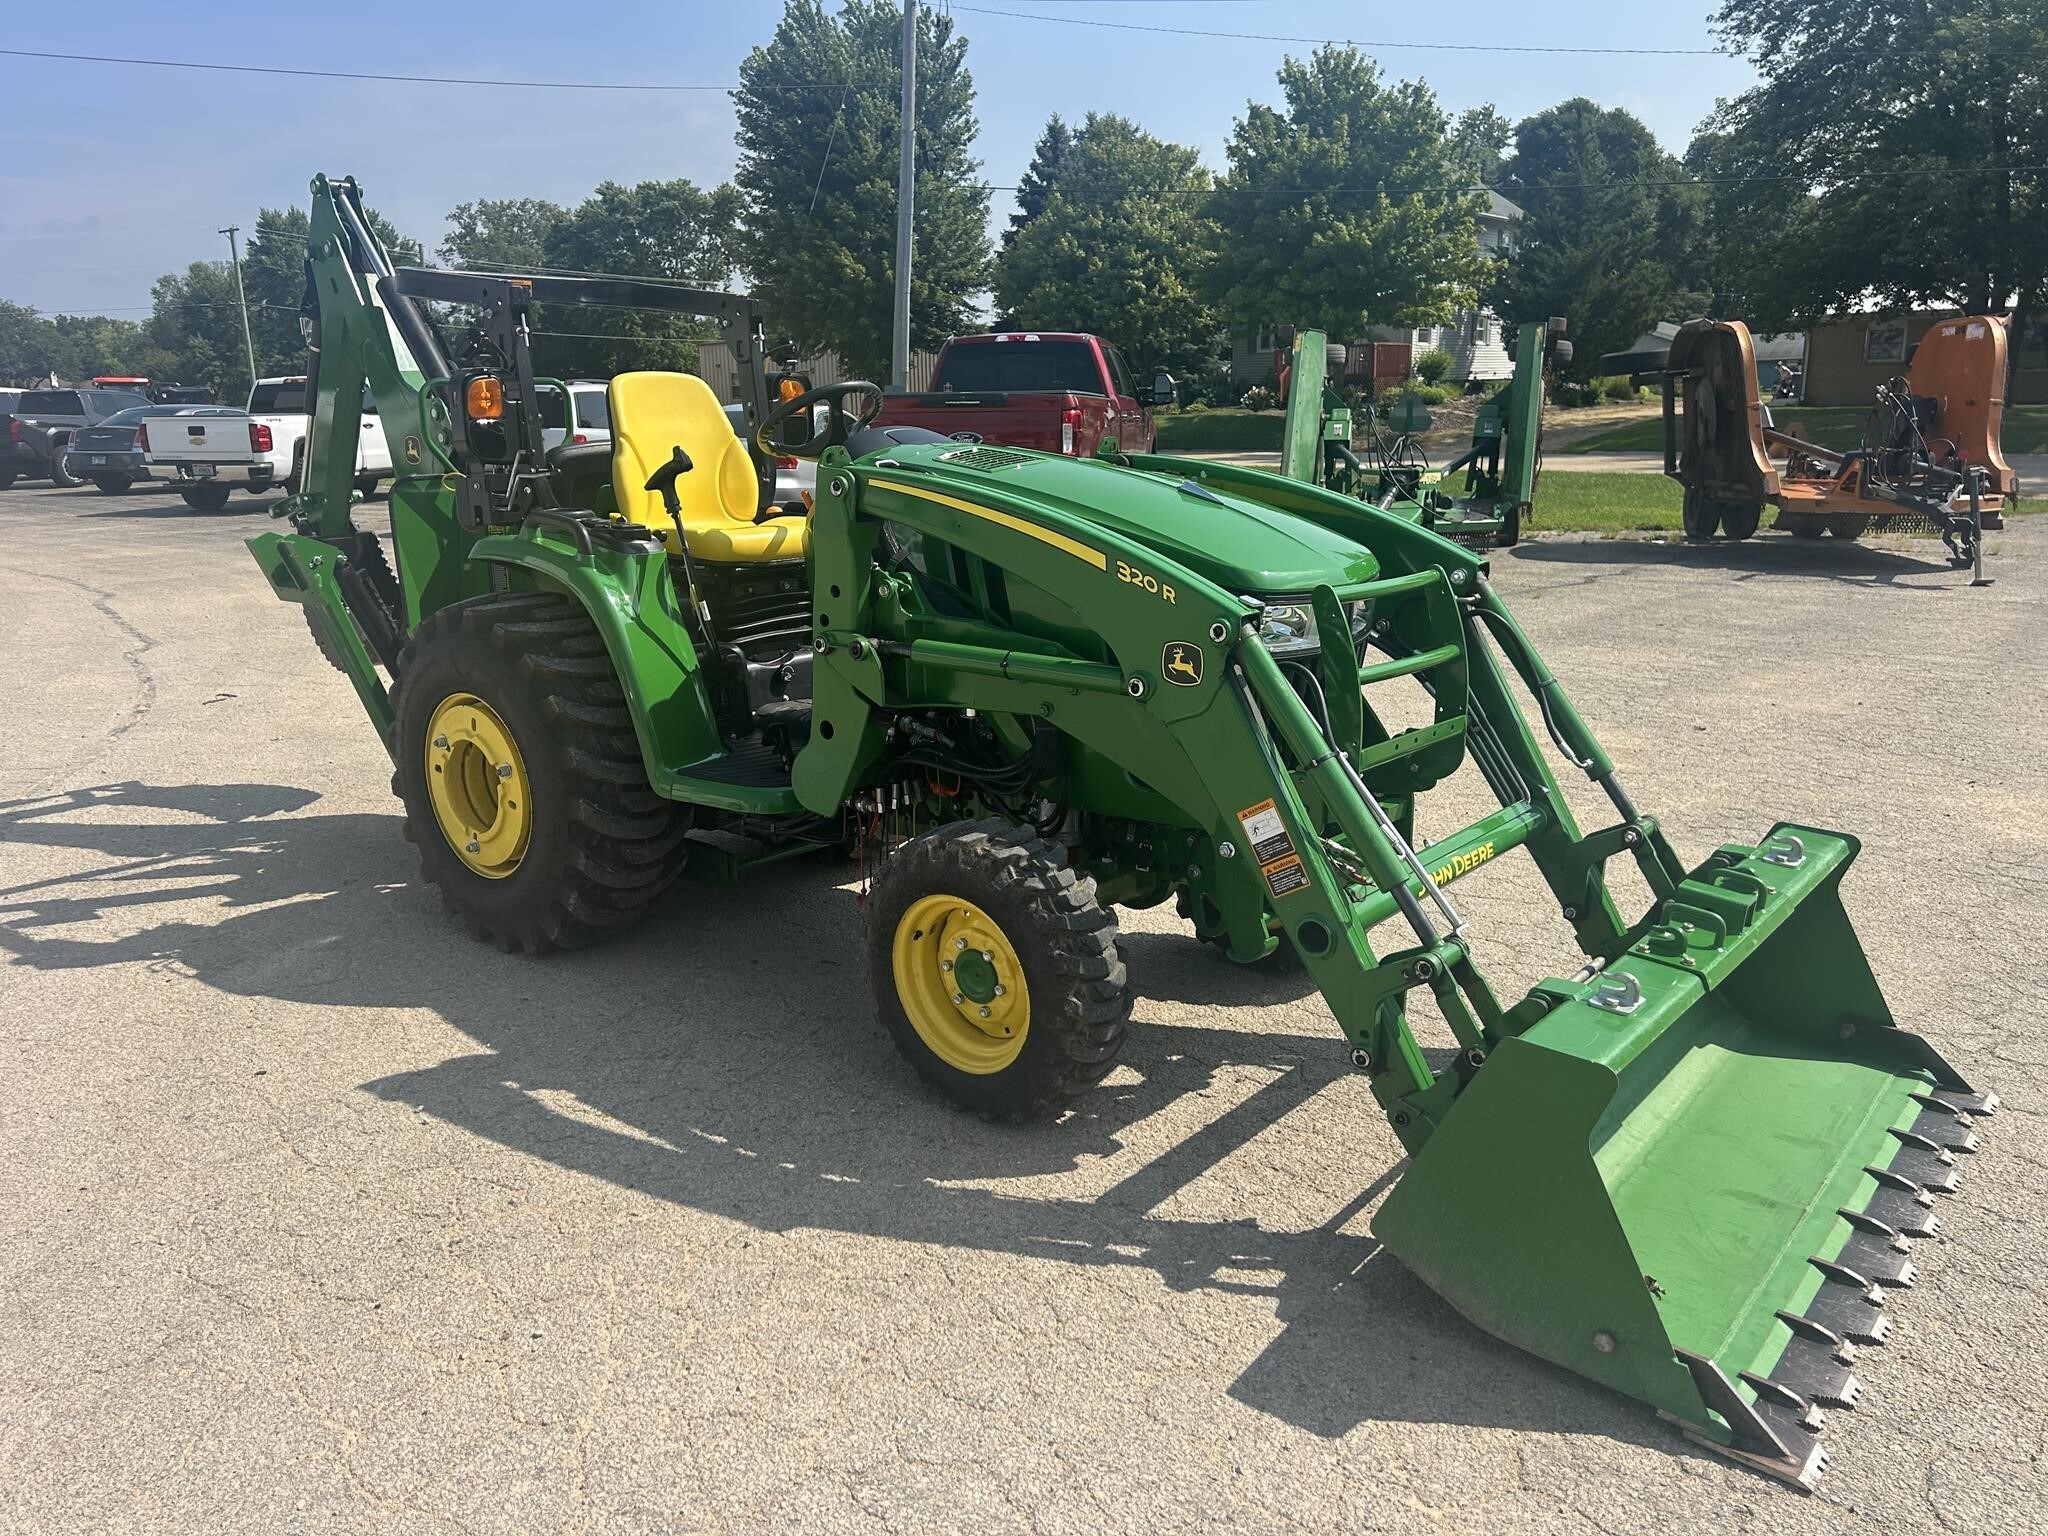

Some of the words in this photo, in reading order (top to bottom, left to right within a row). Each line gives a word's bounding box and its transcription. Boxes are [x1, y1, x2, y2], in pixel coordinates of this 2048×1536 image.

[1116, 560, 1158, 594] 320
[1162, 583, 1177, 605] R
[1247, 802, 1270, 816] WARNING
[1272, 858, 1297, 871] WARNING
[1451, 841, 1494, 876] DEERE
